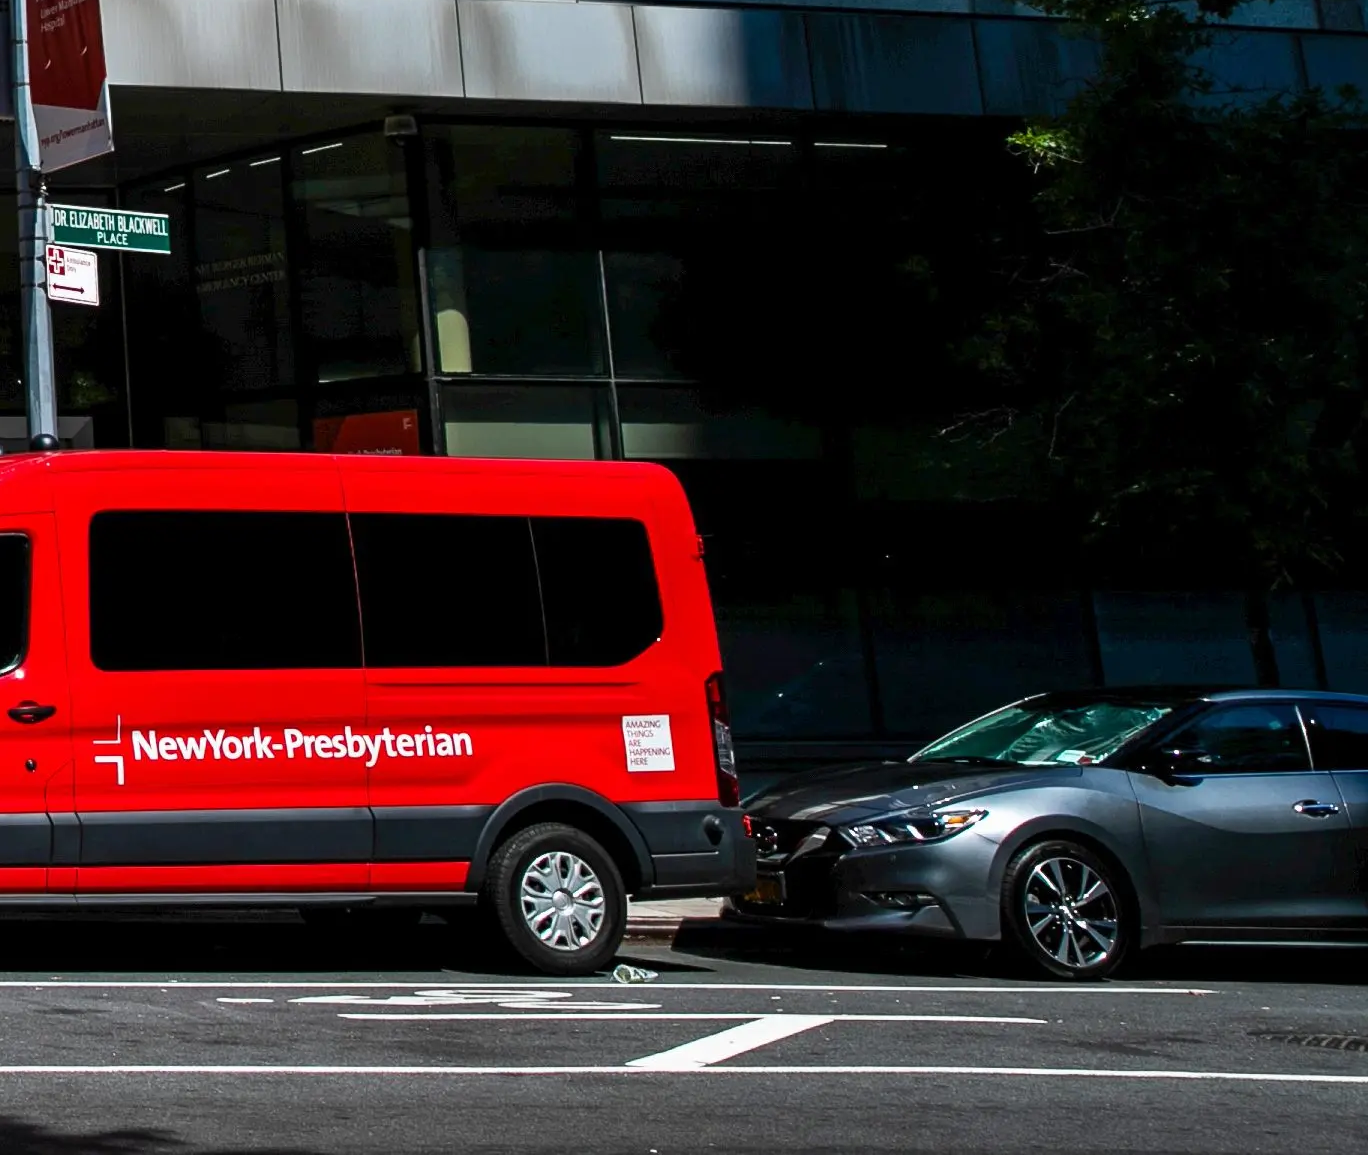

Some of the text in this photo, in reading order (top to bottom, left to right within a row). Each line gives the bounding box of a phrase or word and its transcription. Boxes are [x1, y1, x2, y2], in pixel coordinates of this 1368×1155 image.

[69, 212, 115, 231] ELIZABETH
[117, 215, 169, 236] BLACKWELL
[96, 232, 129, 245] PLACE
[625, 720, 661, 728] AMAZING
[626, 730, 654, 738] THINGS
[131, 724, 474, 768] NewYork-Presbyterian
[628, 739, 642, 747] ARE
[629, 747, 671, 757] HAPPENING
[630, 757, 649, 766] HERE
